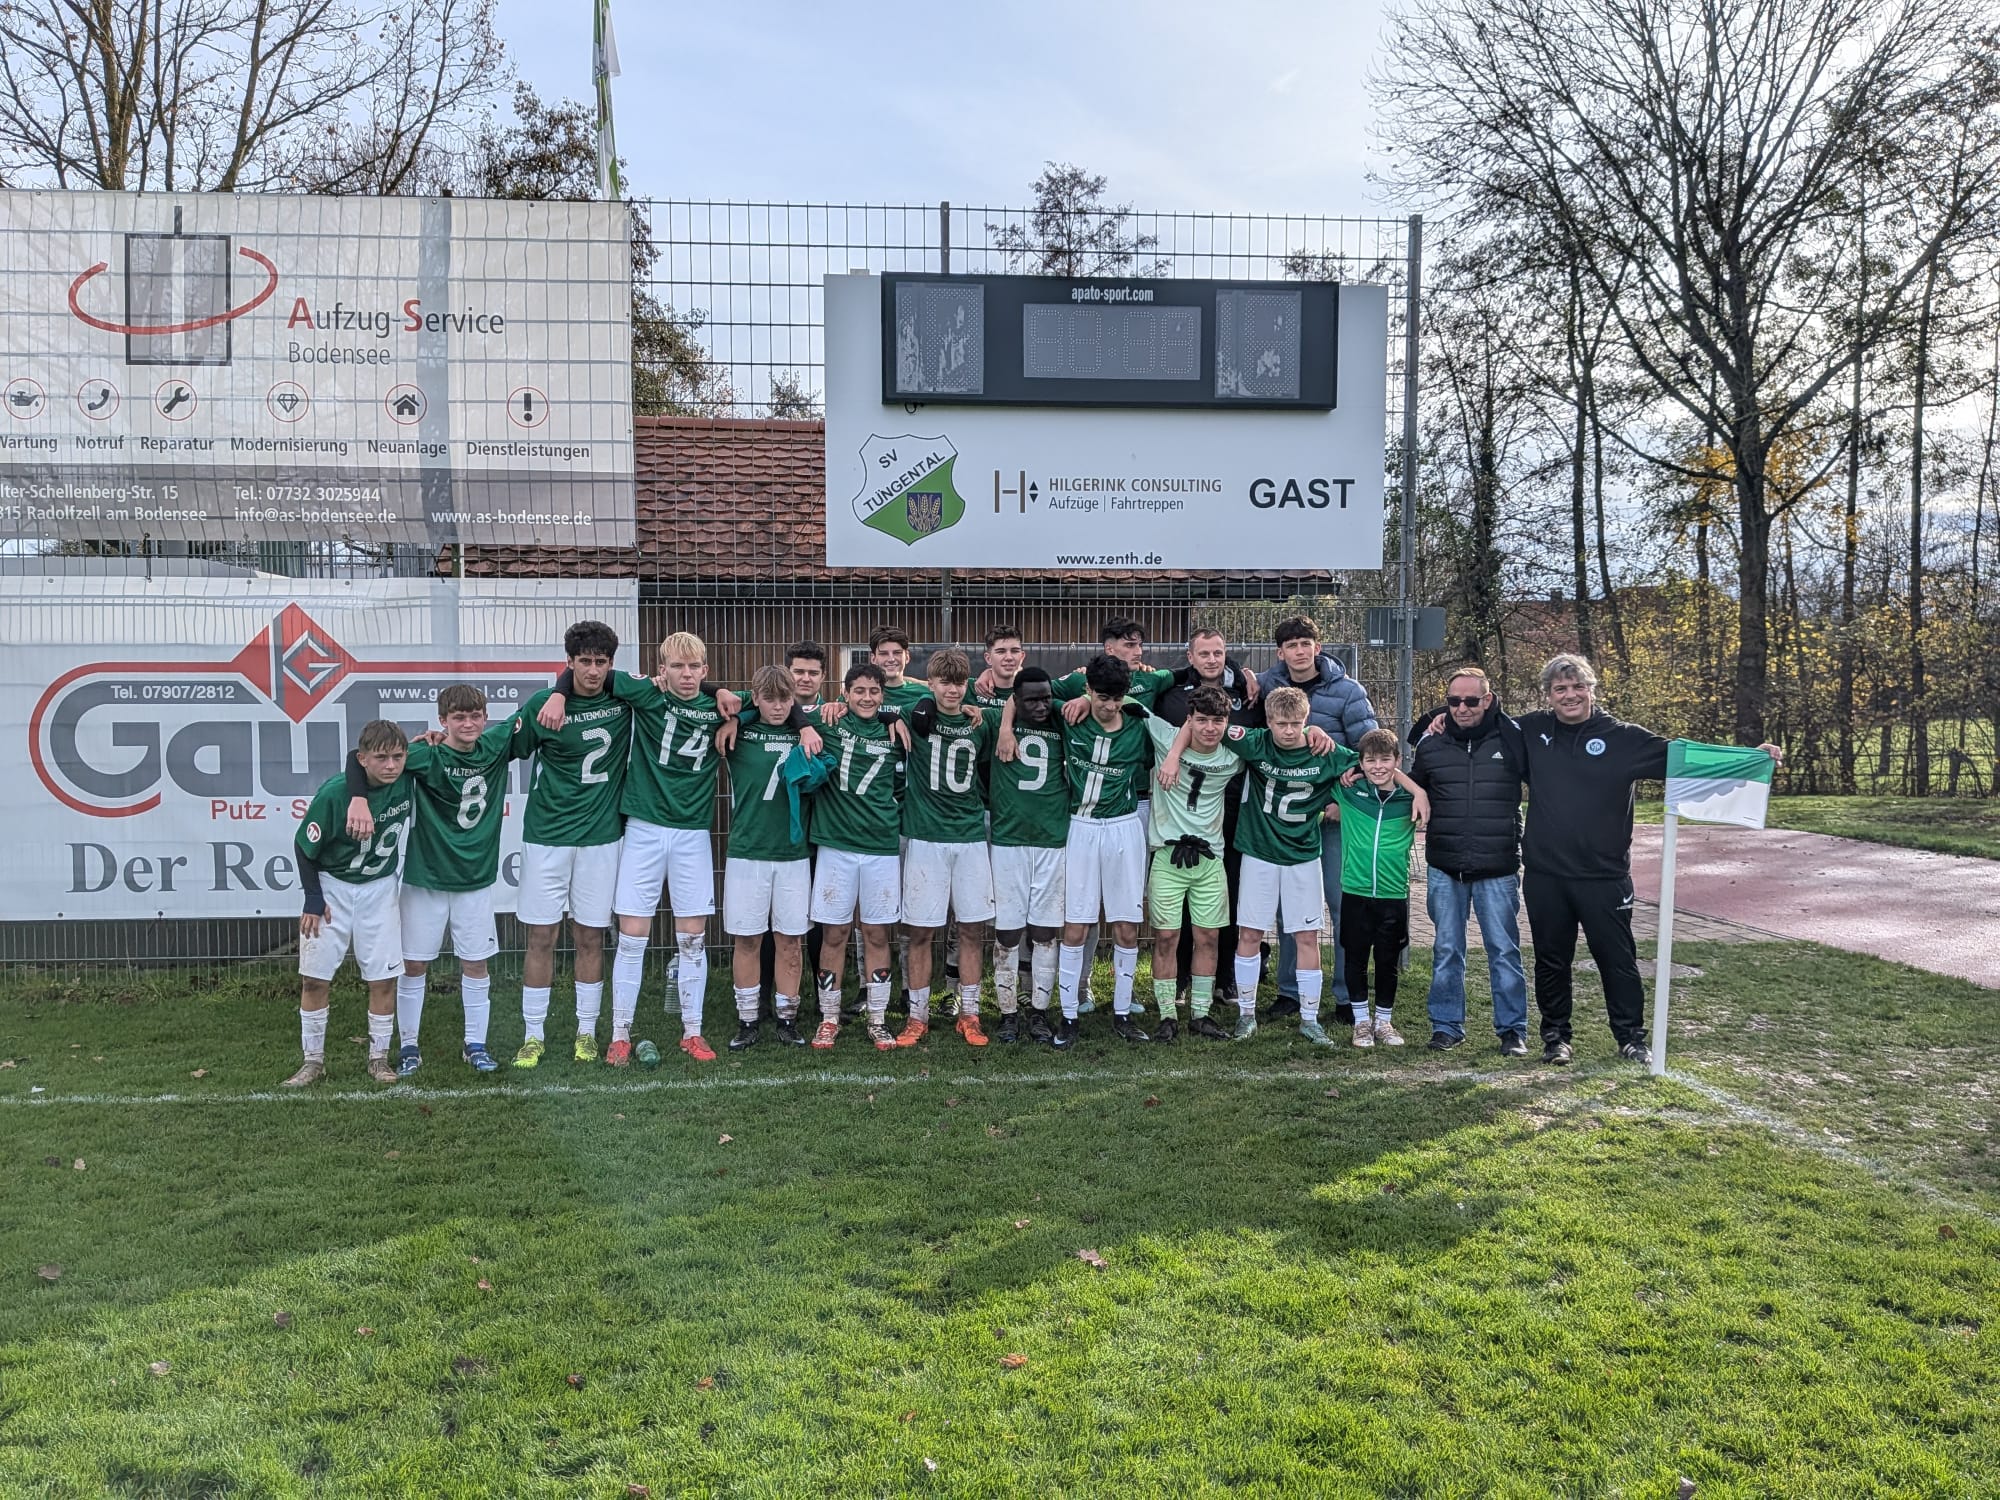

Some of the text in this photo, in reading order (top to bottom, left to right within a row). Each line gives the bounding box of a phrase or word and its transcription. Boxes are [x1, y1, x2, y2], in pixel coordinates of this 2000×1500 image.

[1071, 285, 1154, 303] apato-sport.com
[287, 297, 504, 338] Aufzug-Service
[288, 341, 391, 365] Bodensee
[75, 435, 125, 450] Notruf
[140, 436, 214, 453] Reparatur
[230, 437, 348, 456] Modernisierung
[367, 439, 447, 457] Neuanlage
[467, 441, 590, 460] Dienstleistungen
[878, 448, 898, 469] SV
[862, 452, 946, 512] TÜNGENTAL
[1049, 477, 1222, 493] HILGERINK CONSULTING
[0, 483, 178, 502] lter-Schellenberg-Str. 15
[233, 486, 380, 501] Tel.: 07732 3025944
[1249, 478, 1355, 509] GAST
[27, 505, 101, 520] Radolfzell
[106, 510, 129, 520] am
[135, 507, 207, 521] Bodensee
[1048, 496, 1184, 513] Aufzüge Fahrtreppen
[235, 507, 397, 523] info@as-bodensee.de
[431, 509, 592, 526] www.as-bodensee.de
[1056, 552, 1163, 565] www.zenth.de
[110, 685, 235, 700] Tel. 07907/2812
[378, 685, 519, 701] www.gl.de
[659, 710, 710, 772] 14
[581, 727, 612, 784] 2
[928, 734, 976, 793] 10
[1018, 735, 1049, 791] 9
[763, 742, 794, 800] 7
[839, 737, 891, 795] 17
[1271, 766, 1321, 777] ALTENMÜNSTER
[457, 775, 487, 829] 8
[1262, 776, 1314, 822] 12
[211, 801, 267, 820] Putz
[345, 822, 403, 876] 19
[66, 843, 188, 893] Der
